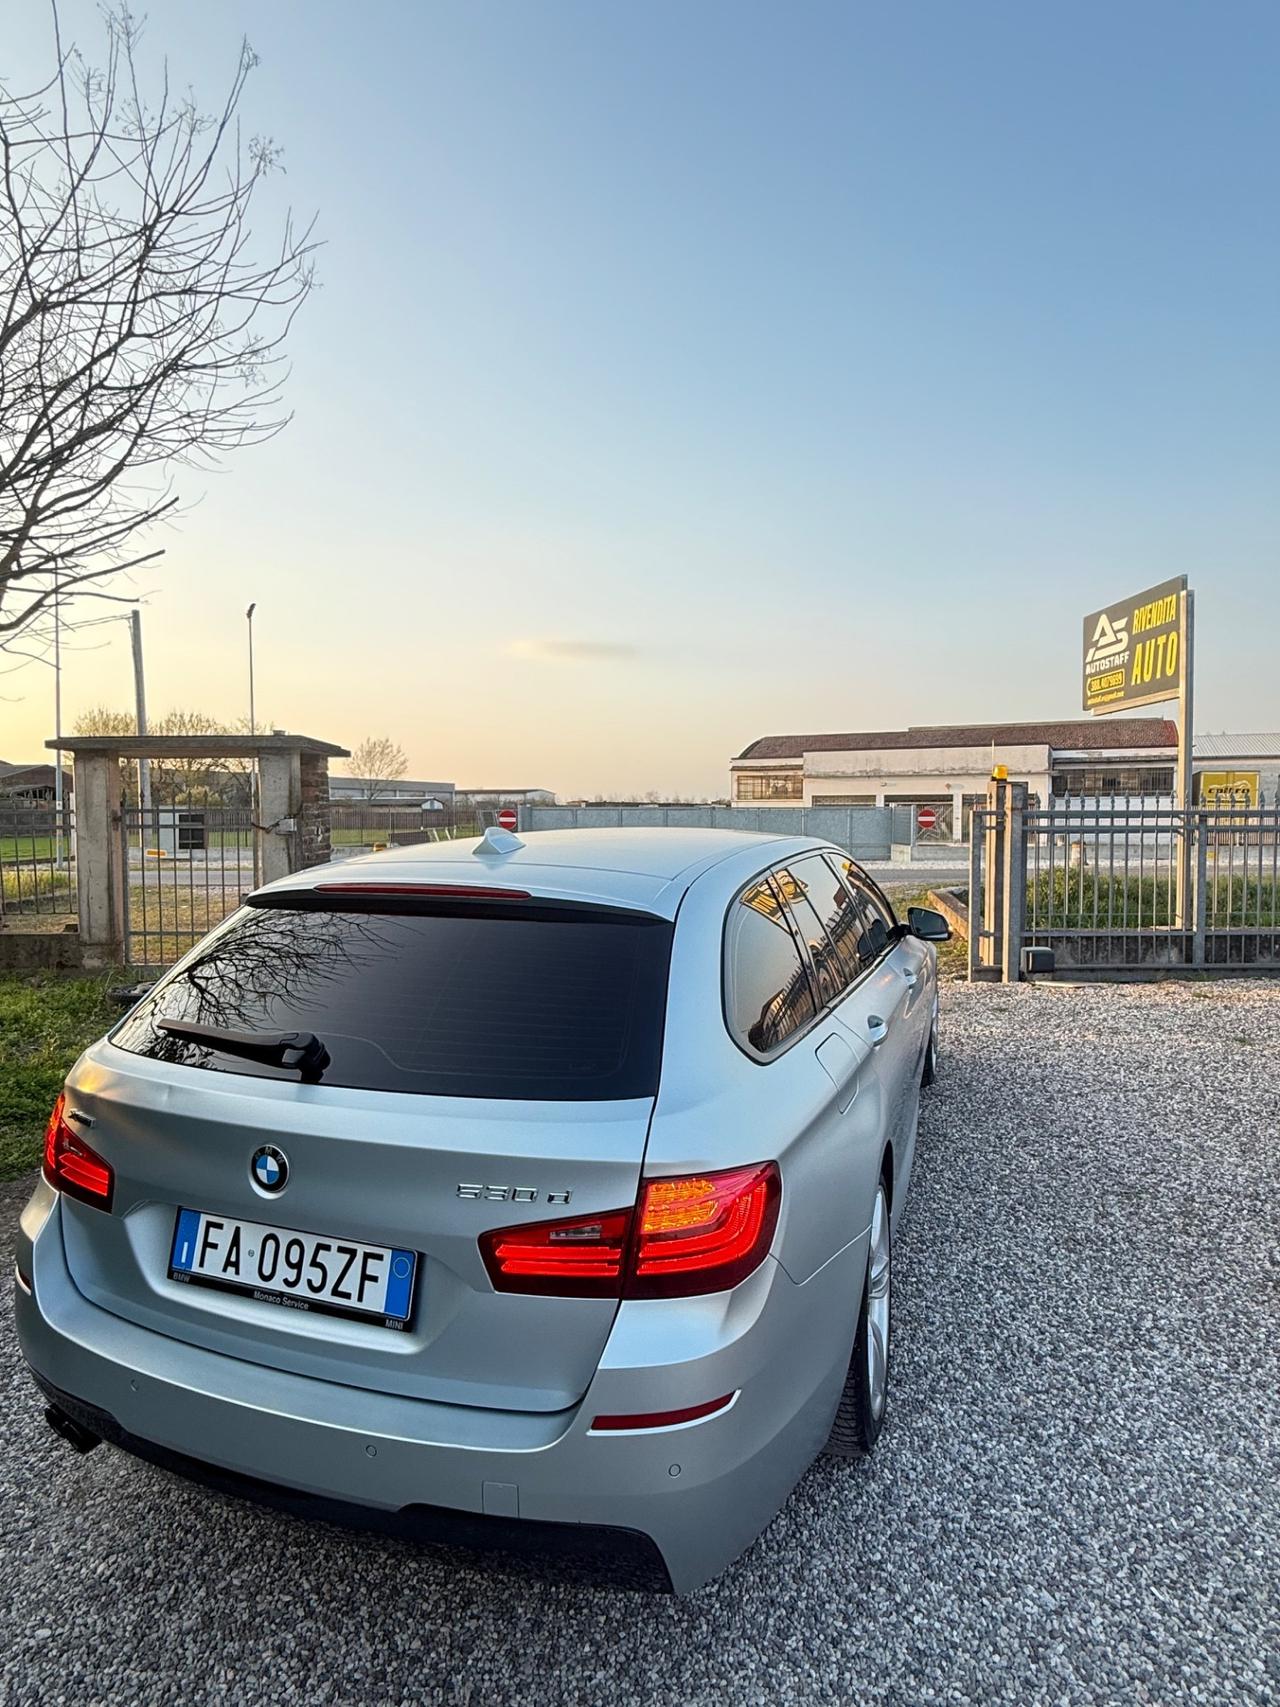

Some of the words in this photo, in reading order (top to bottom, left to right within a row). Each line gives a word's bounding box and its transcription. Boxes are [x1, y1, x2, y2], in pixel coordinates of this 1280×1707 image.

[1132, 593, 1177, 635] RIVENDITA
[1085, 651, 1130, 675] AUTOSTAFF
[1131, 631, 1178, 686] AUTO
[457, 1183, 538, 1203] 530
[547, 1190, 573, 1205] d
[198, 1219, 242, 1276] FA
[257, 1231, 385, 1303] 095ZF
[173, 1271, 191, 1284] BMW
[253, 1290, 281, 1305] Monaco
[282, 1296, 310, 1310] Service
[385, 1318, 404, 1331] MINI
